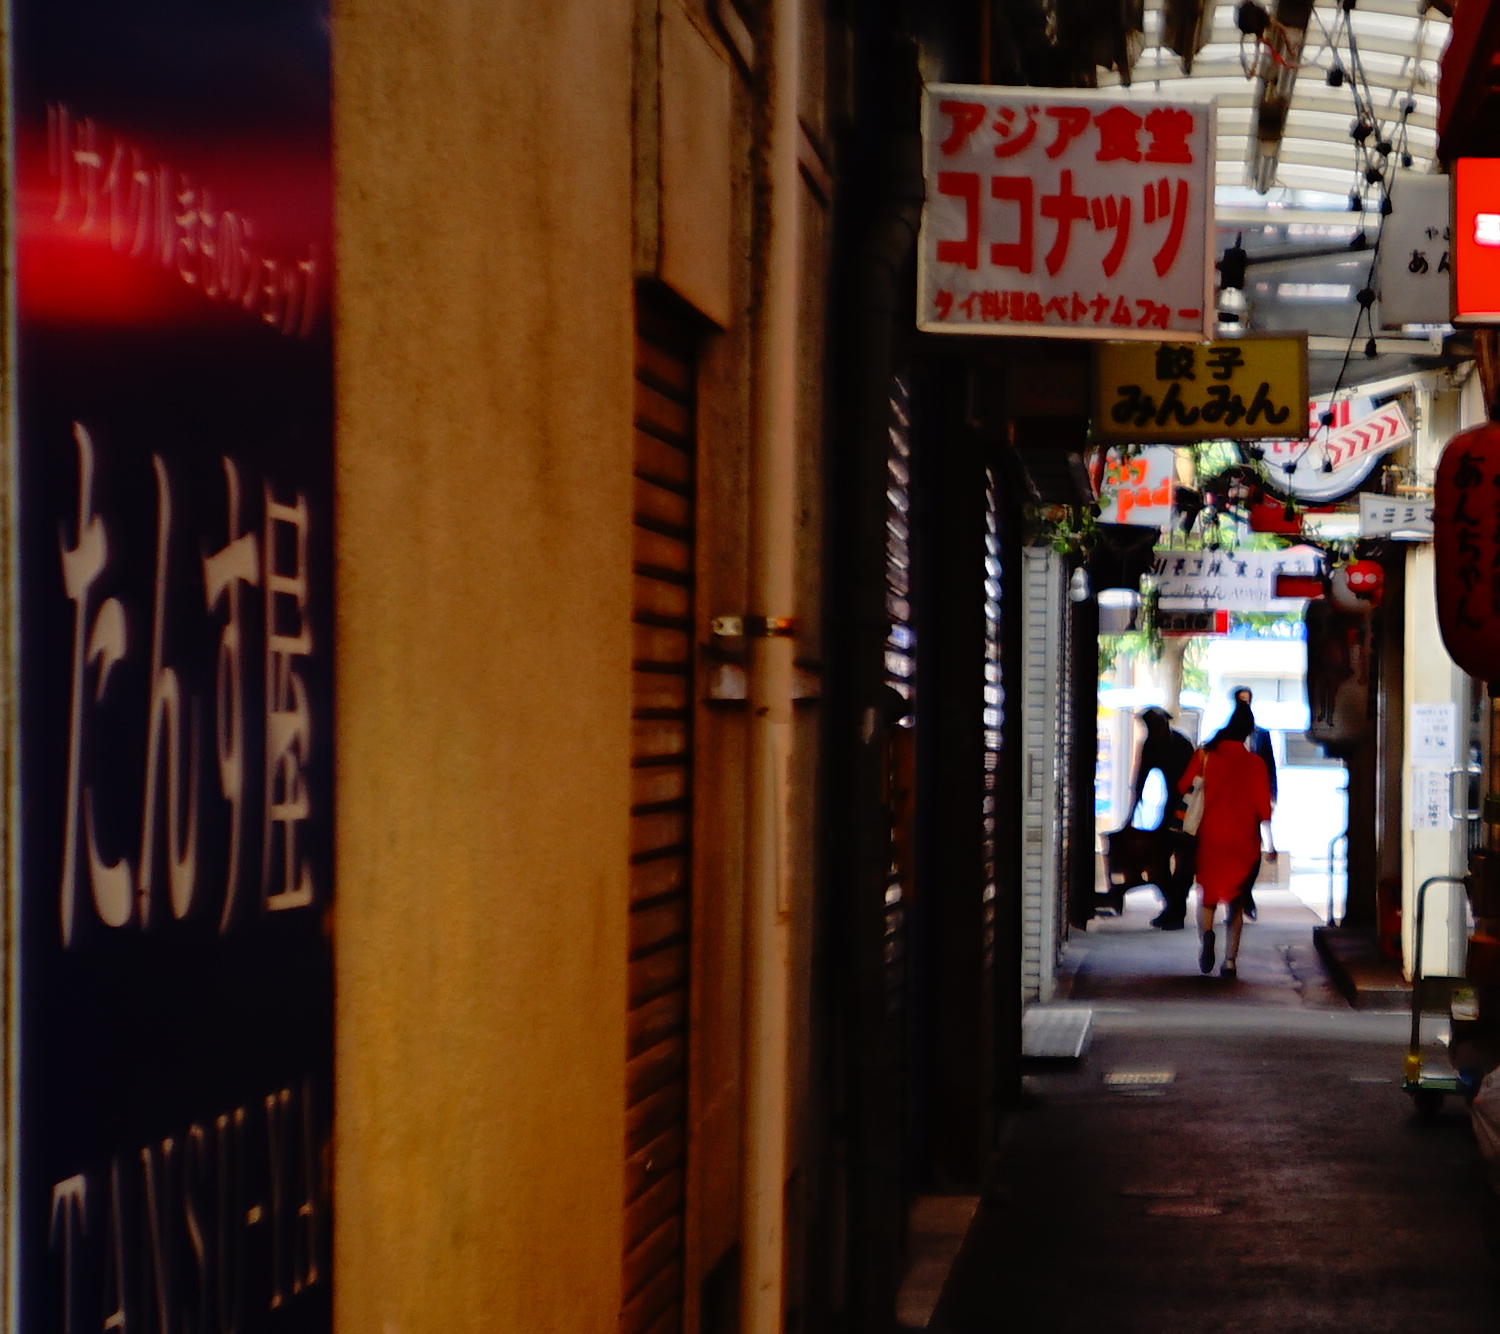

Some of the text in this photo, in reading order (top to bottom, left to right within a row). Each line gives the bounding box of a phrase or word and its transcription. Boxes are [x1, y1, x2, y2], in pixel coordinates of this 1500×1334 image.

[938, 100, 1194, 164] アジア食堂
[45, 99, 318, 339] リサイクルきものショップ
[936, 168, 1189, 279] ココナッツ
[1110, 381, 1291, 427] みんみん
[1154, 345, 1244, 381] 餃子
[1116, 477, 1170, 522] pad
[1453, 449, 1484, 630] あんちゃん
[56, 415, 317, 951] たんす屋
